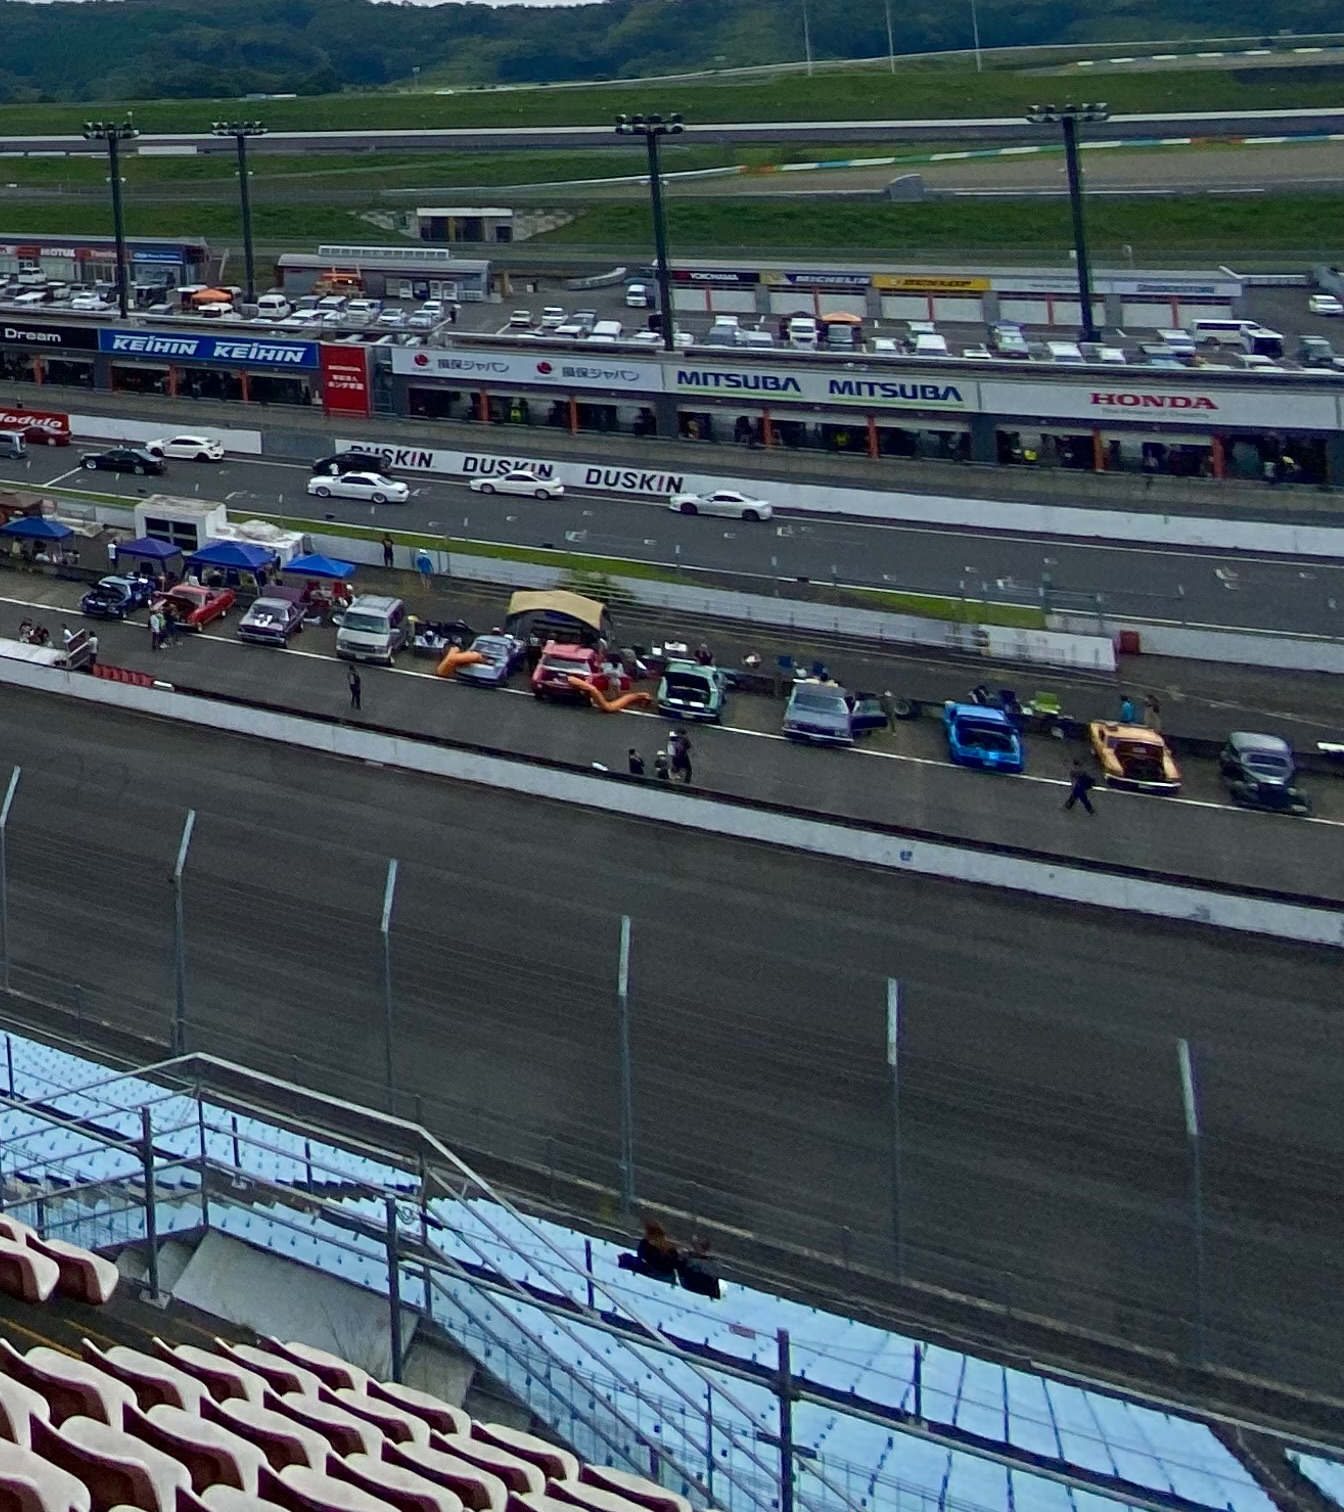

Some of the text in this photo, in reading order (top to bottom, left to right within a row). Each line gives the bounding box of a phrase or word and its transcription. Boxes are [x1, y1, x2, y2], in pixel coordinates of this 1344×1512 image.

[41, 248, 75, 258] MOTUL
[796, 276, 870, 284] MICHELIN
[903, 279, 972, 287] DUNLOP
[4, 328, 62, 343] Dream
[438, 358, 509, 373] 損保ジャパン
[562, 366, 639, 382] 損保ジャパン
[677, 370, 963, 402] MITSUBA MITSUBA
[1090, 393, 1219, 409] HONDA
[585, 469, 683, 494] DUSKIN
